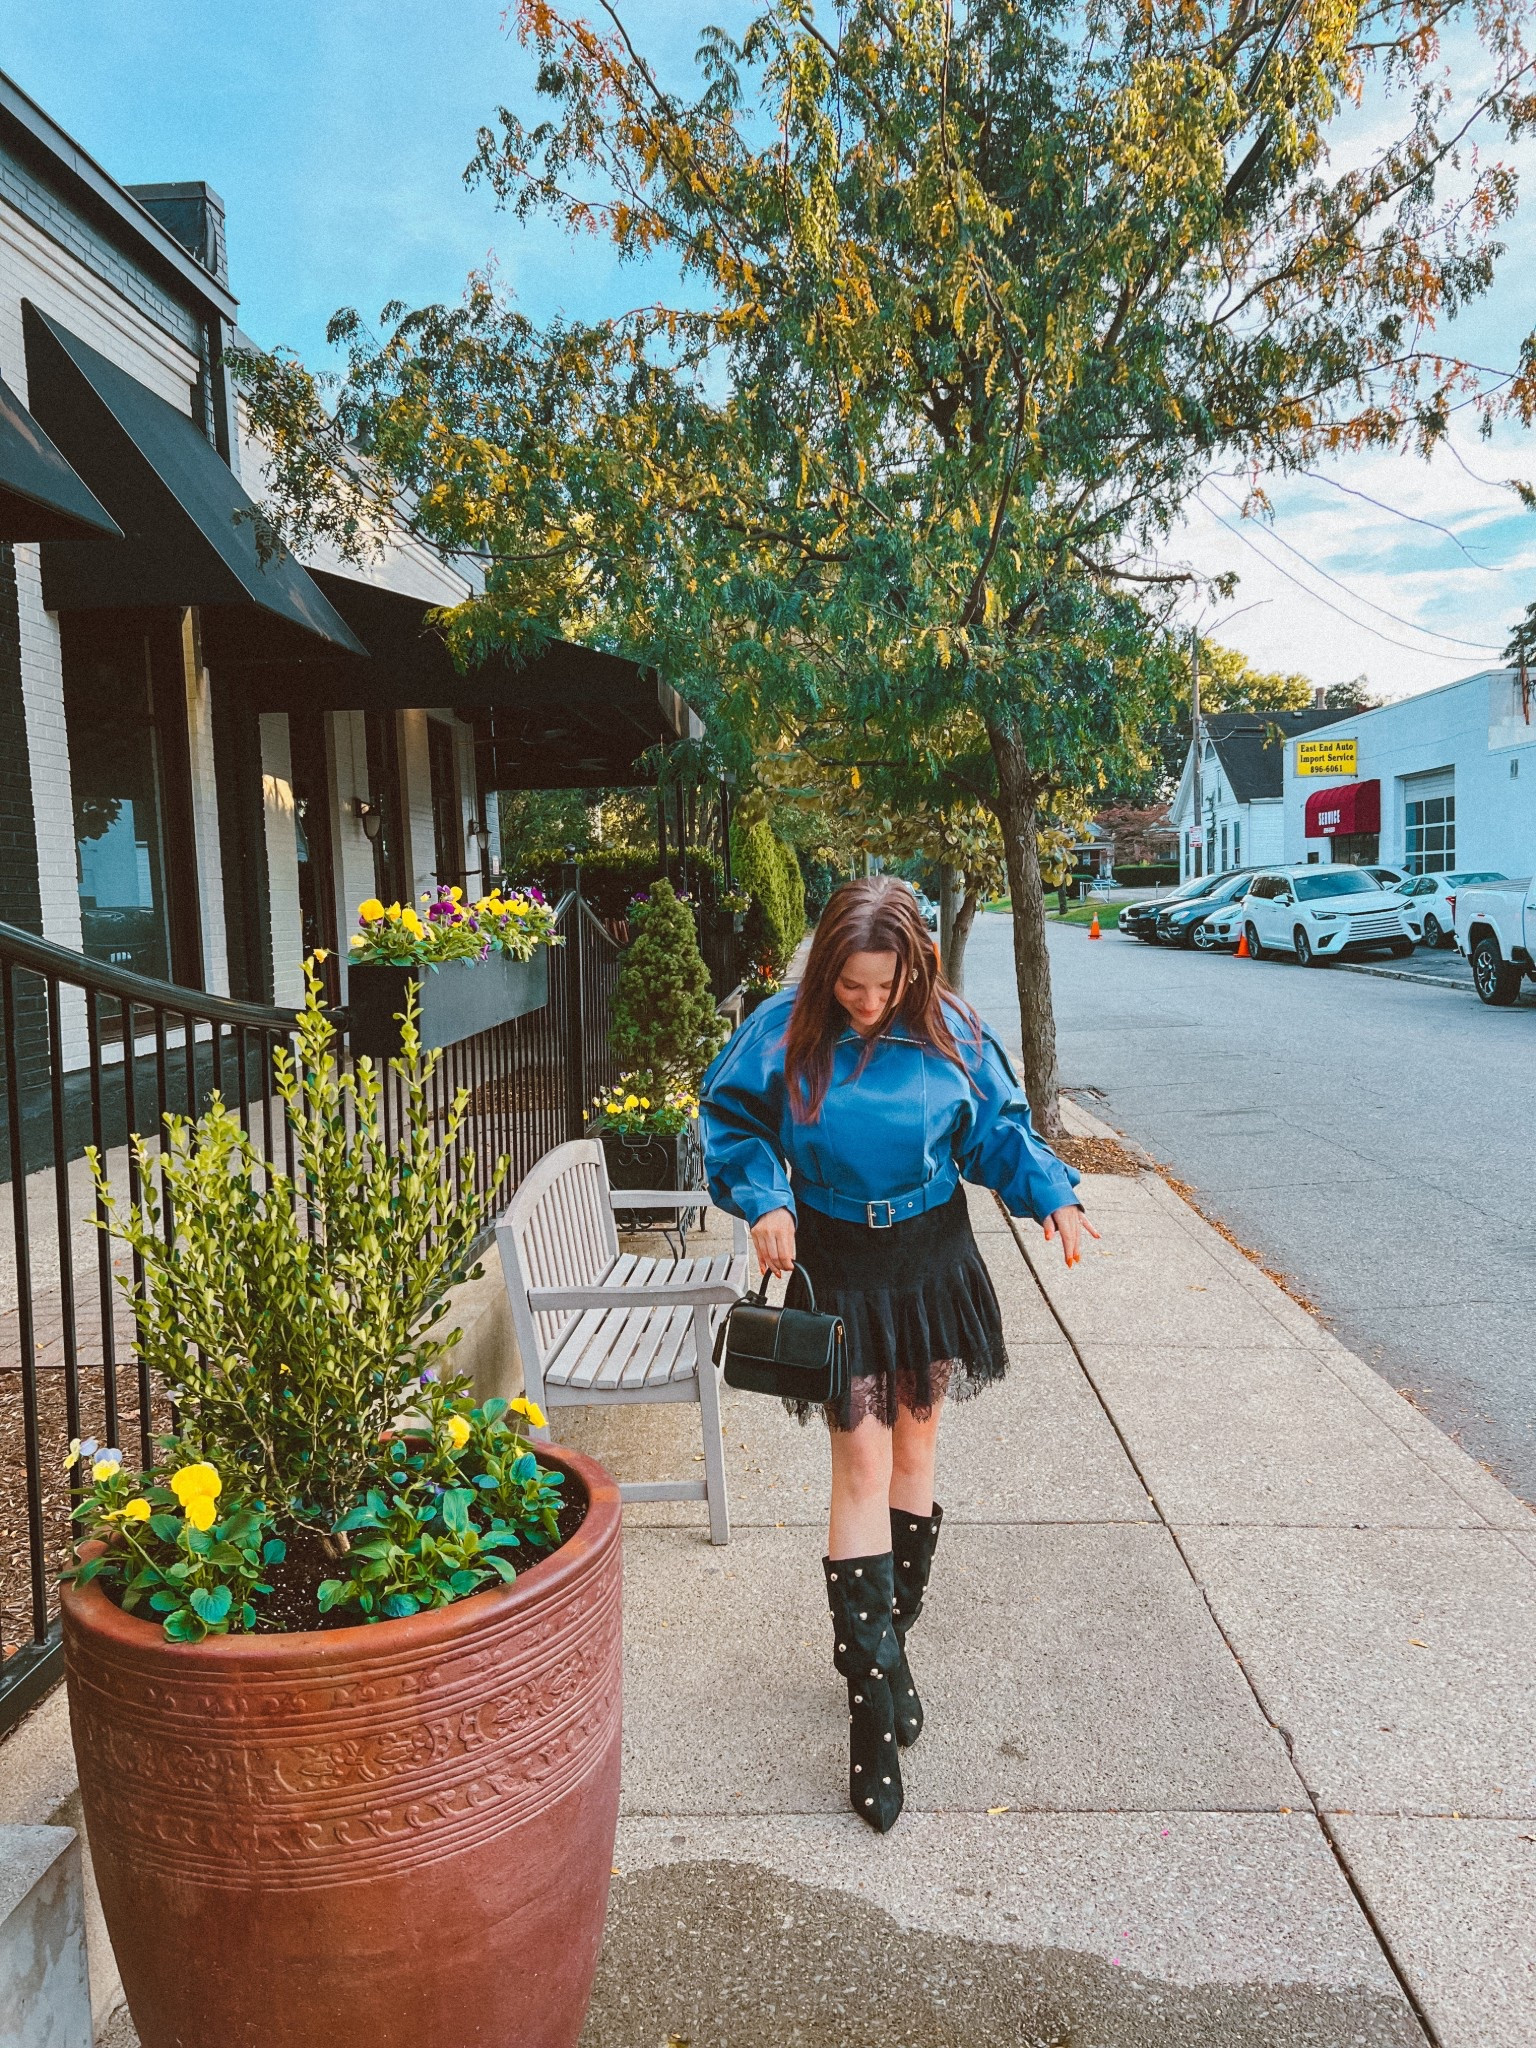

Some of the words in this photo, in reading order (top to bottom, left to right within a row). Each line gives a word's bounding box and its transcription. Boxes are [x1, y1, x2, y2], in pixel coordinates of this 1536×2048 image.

[1300, 744, 1316, 752] East
[1319, 743, 1333, 751] End
[1336, 743, 1354, 751] Auto
[1300, 755, 1325, 764] Import
[1327, 753, 1354, 761] Service
